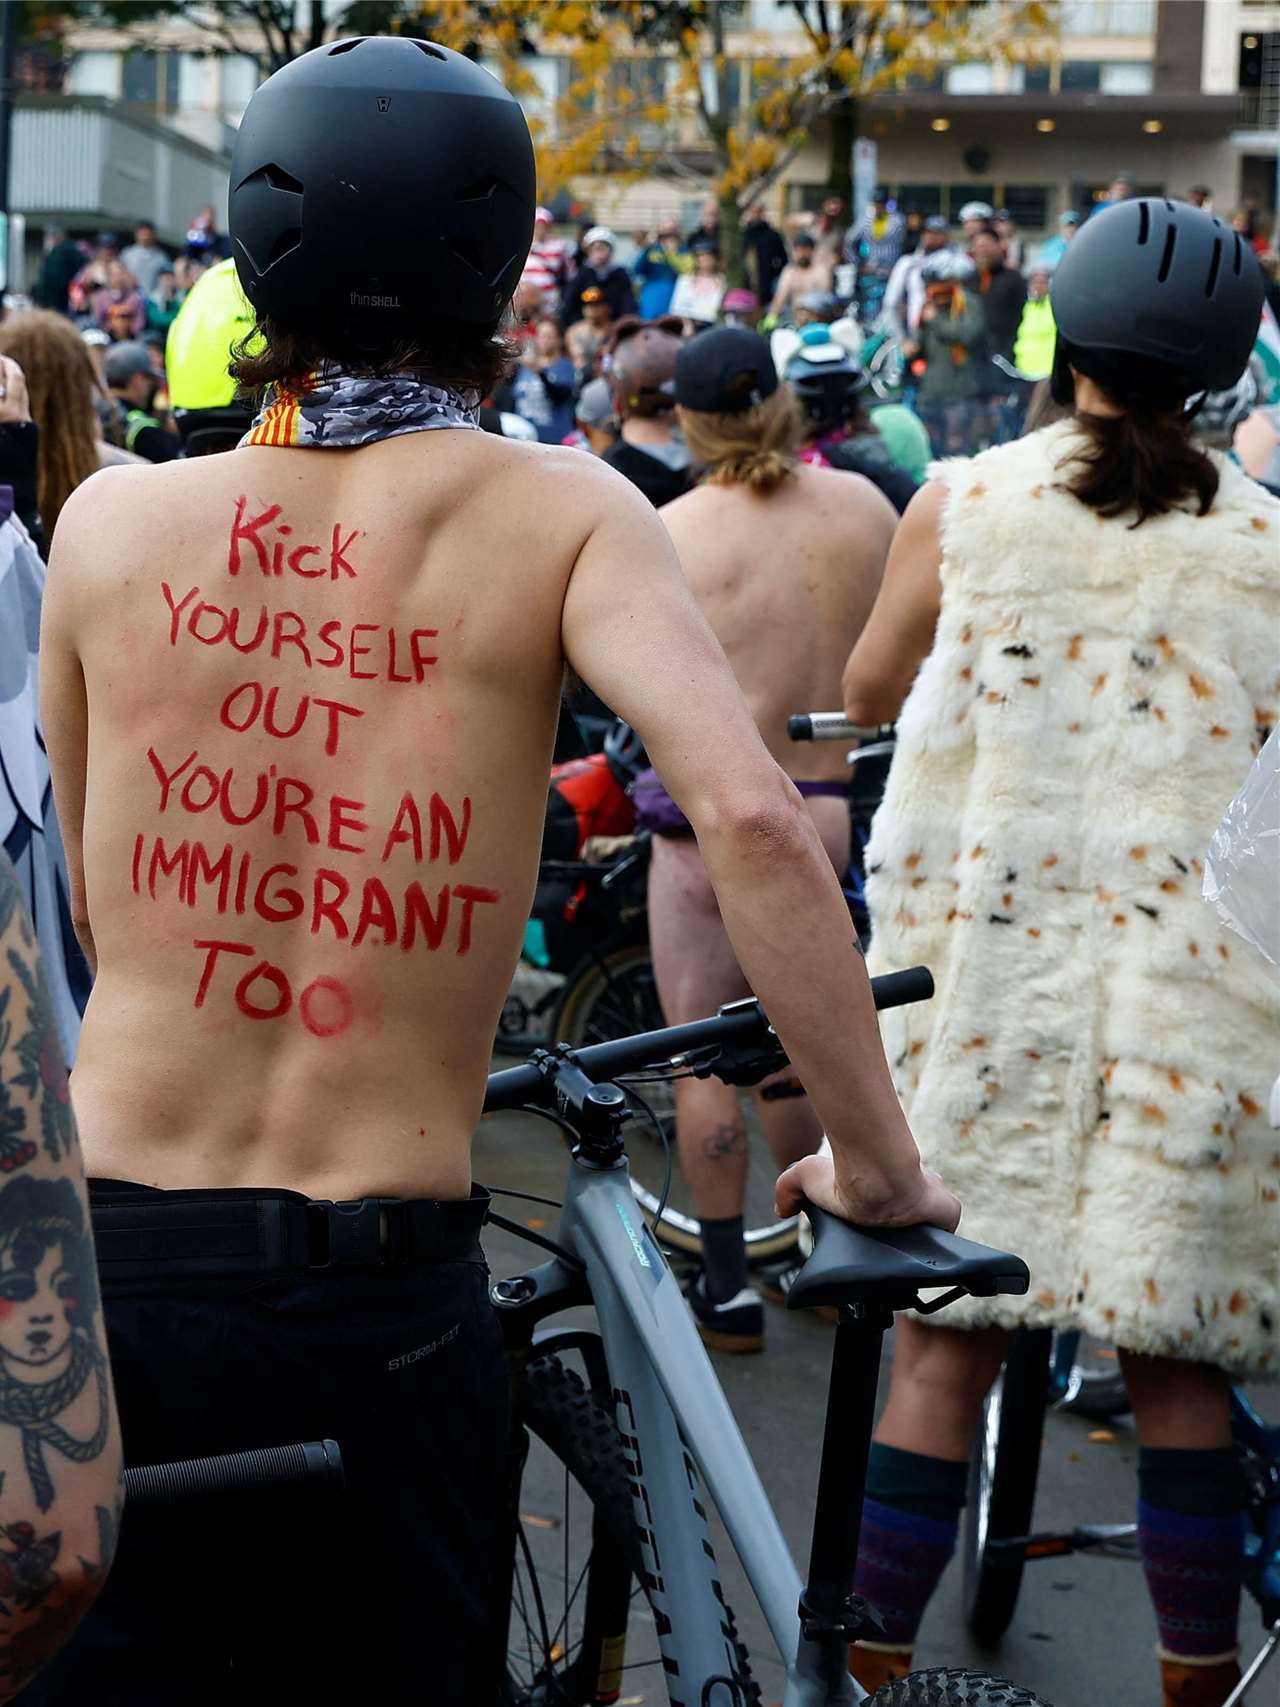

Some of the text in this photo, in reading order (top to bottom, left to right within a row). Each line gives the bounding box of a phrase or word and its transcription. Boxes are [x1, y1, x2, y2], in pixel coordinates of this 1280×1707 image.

[161, 582, 439, 684] YOURSELF
[220, 681, 365, 757] OUT
[147, 747, 473, 865] YOU'RE AN
[132, 834, 500, 955] IMMIGRANT
[193, 939, 355, 1039] TOO
